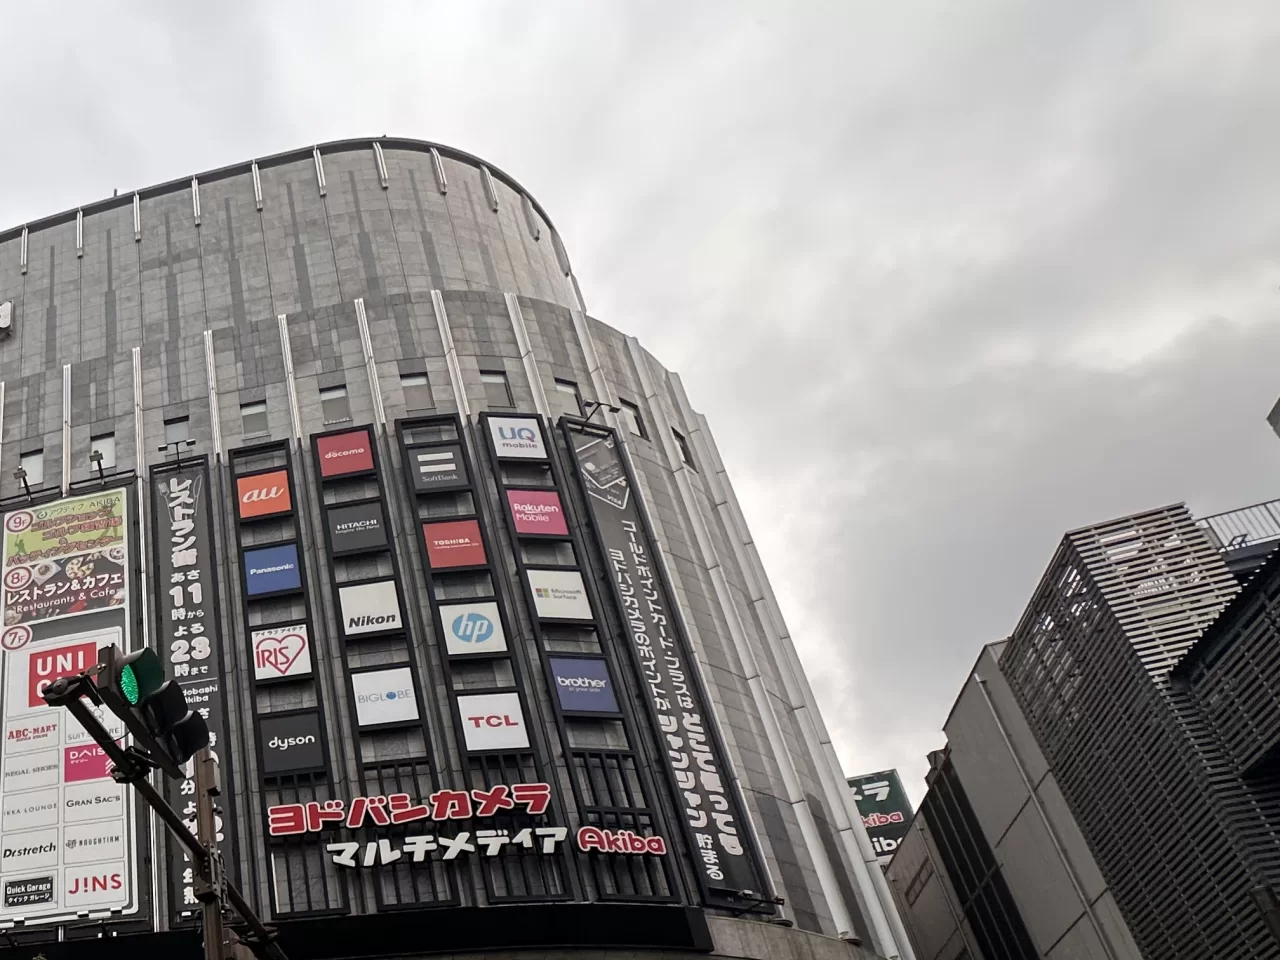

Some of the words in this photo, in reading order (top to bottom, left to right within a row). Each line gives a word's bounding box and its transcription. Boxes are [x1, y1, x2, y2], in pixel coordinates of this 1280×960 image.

[498, 426, 537, 443] UQ
[501, 441, 538, 450] mobile
[324, 447, 365, 459] docomo
[422, 474, 458, 483] SoftBank
[242, 484, 285, 504] au
[514, 503, 558, 514] Rakuten
[336, 519, 377, 530] HITACHI
[516, 513, 549, 522] Mobile
[433, 538, 471, 546] TOSHIBA
[250, 563, 294, 575] Panasonic
[11, 573, 27, 585] 8F
[171, 570, 200, 583] あさ
[7, 573, 122, 605] レストラン&カフェ
[170, 583, 202, 607] 11
[17, 596, 74, 613] Restaurants
[79, 592, 86, 600] &
[91, 587, 116, 598] Cafe
[172, 608, 204, 621] 時から
[348, 613, 396, 628] Nikon
[174, 623, 204, 637] よる
[458, 613, 489, 641] hp
[9, 631, 24, 644] 7F
[170, 637, 211, 663] 23
[36, 651, 84, 676] UNI
[255, 646, 289, 670] IRIS
[174, 663, 208, 677] 時まで
[557, 676, 606, 688] brother
[358, 689, 413, 704] BIGLOBE
[468, 715, 519, 728] TCL
[8, 724, 57, 740] ABC-MART
[68, 732, 85, 741] SUIT
[268, 734, 316, 750] dyson
[5, 768, 31, 778] REGAL
[33, 764, 58, 774] SHOES
[24, 802, 57, 813] LOUNGE
[66, 798, 92, 808] GRAN
[268, 783, 550, 836] ヨドバシカメラ
[861, 812, 904, 828] kiba
[3, 842, 56, 858] Dr.stretch
[326, 827, 567, 867] マルチメディア
[577, 826, 667, 855] Akiba
[7, 884, 25, 895] Quick
[27, 882, 51, 893] Garage
[69, 874, 122, 894] J!NS
